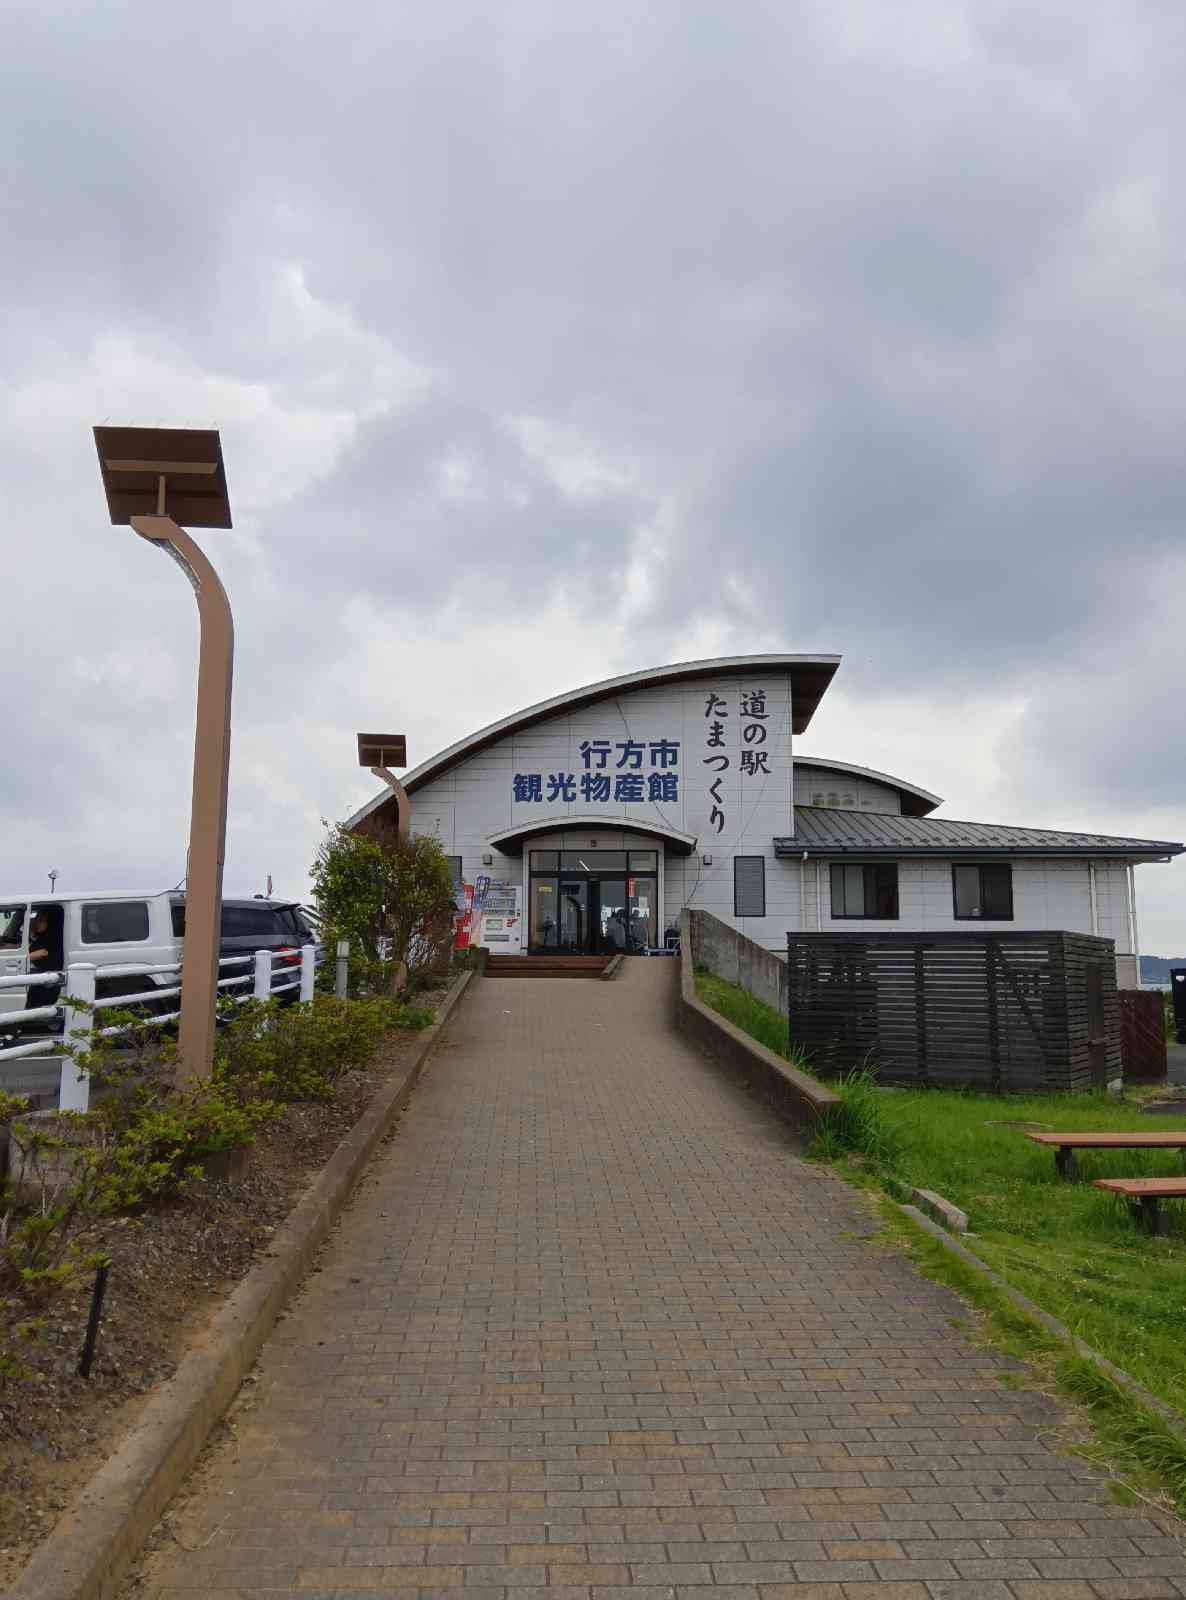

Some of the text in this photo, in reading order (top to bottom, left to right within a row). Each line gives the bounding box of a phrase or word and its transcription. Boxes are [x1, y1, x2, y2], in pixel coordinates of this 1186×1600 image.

[579, 739, 680, 769] 行方市
[739, 689, 772, 776] 道の駅
[513, 772, 679, 803] 観光物産館
[702, 693, 731, 834] たまつくり
